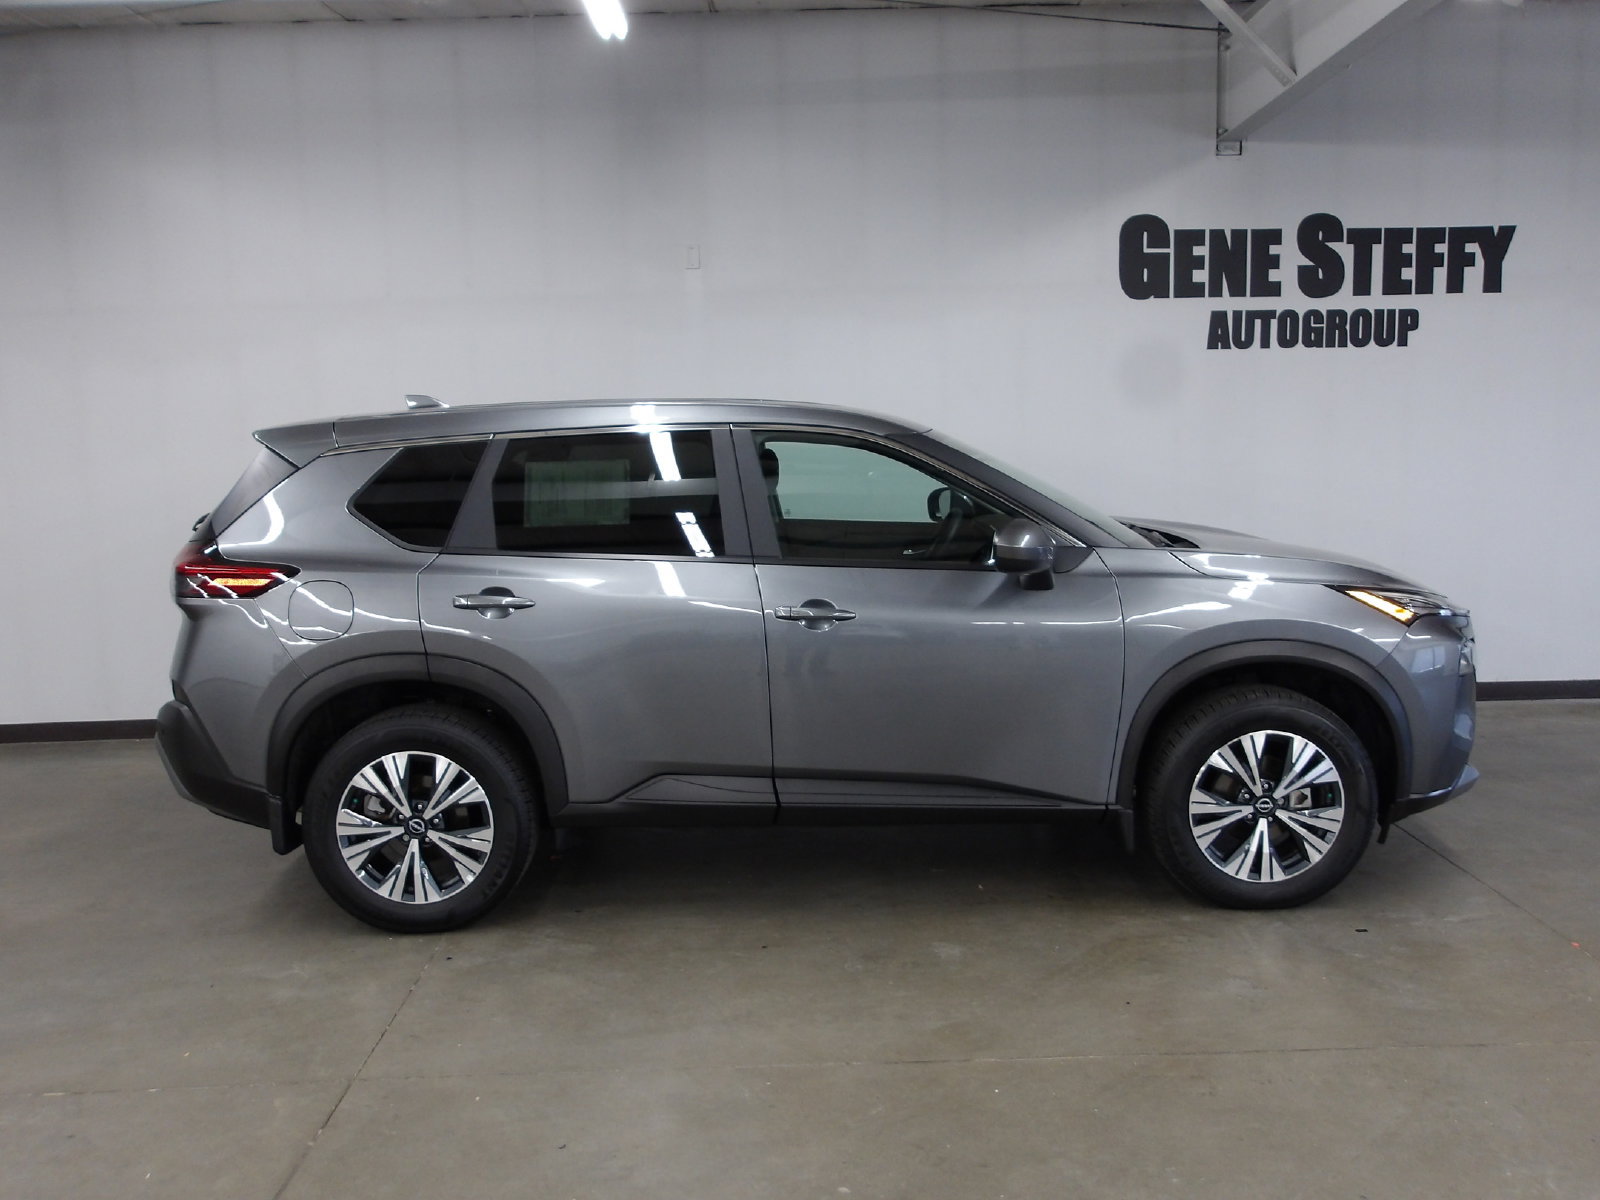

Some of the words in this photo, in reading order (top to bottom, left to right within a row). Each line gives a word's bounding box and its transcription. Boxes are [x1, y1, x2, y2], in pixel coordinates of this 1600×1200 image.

[1119, 213, 1282, 300] GENE
[1297, 213, 1517, 298] STEFFY
[1207, 308, 1420, 350] AUTOGROUP
